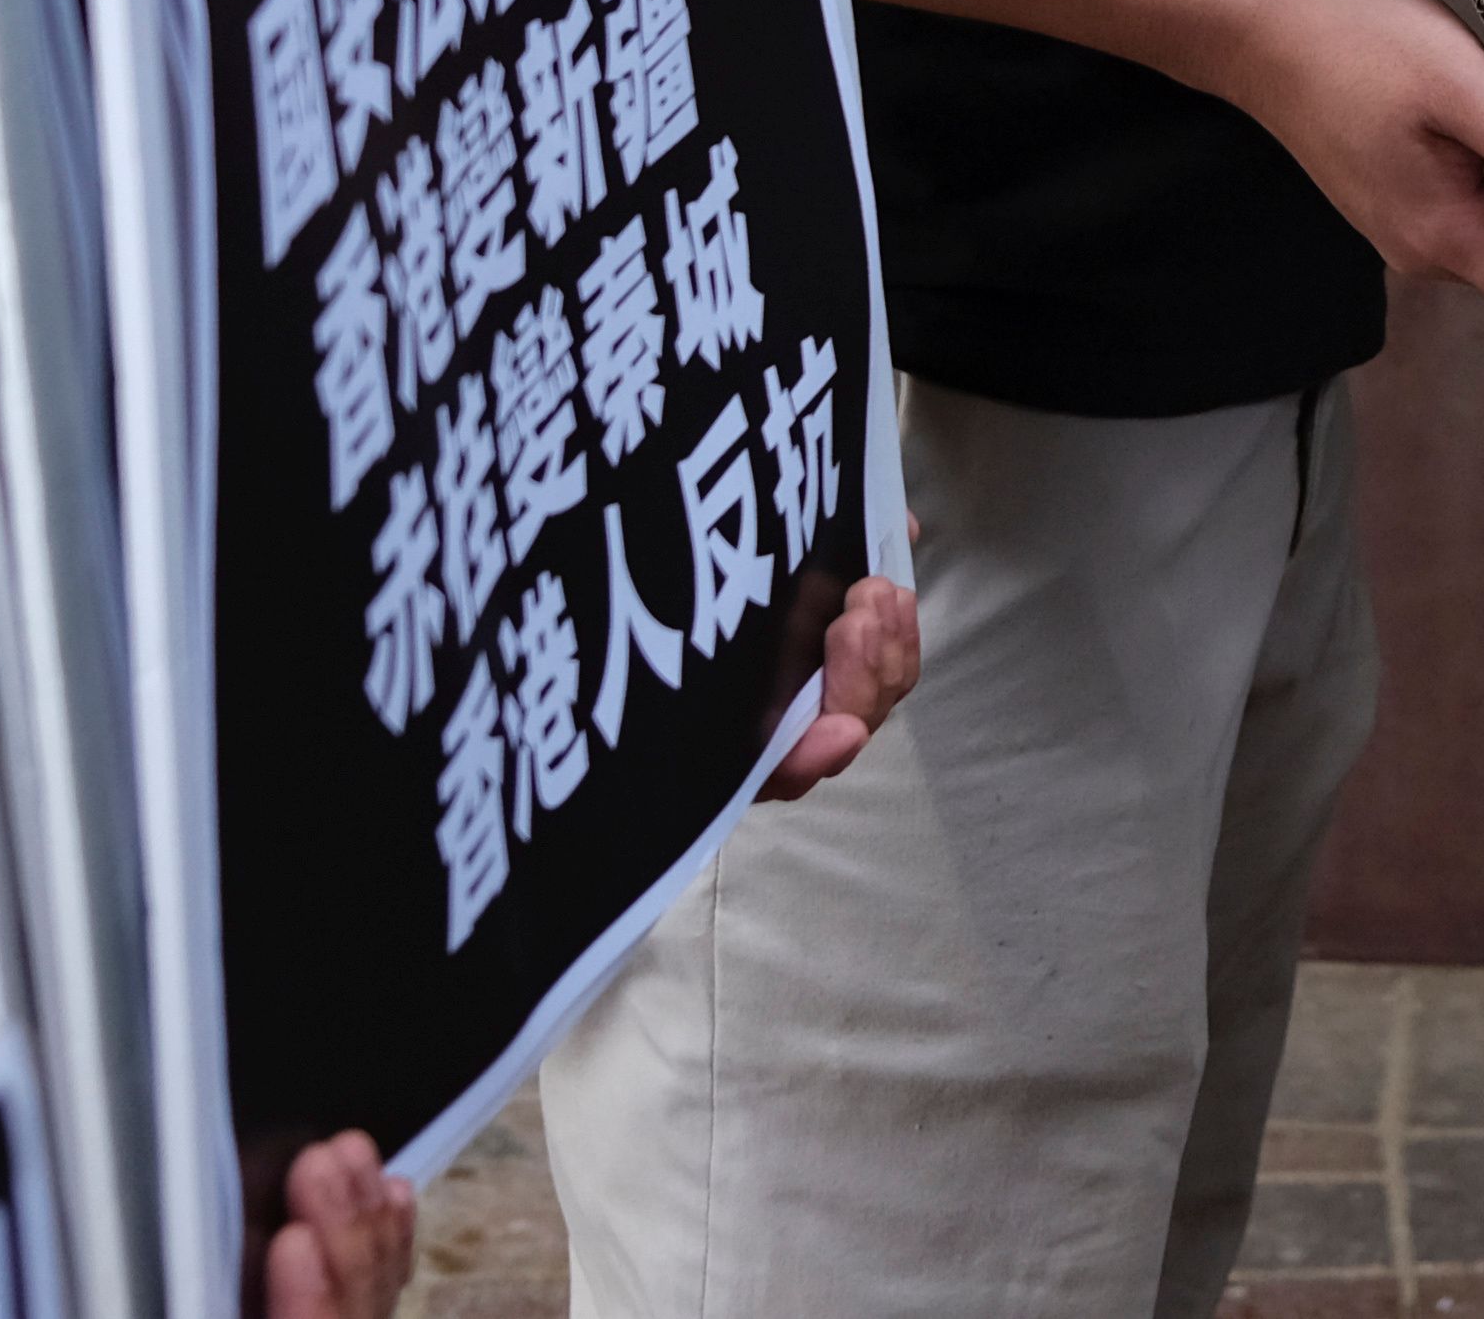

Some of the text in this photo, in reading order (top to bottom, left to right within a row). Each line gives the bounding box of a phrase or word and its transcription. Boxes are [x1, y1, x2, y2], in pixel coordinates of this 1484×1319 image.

[365, 136, 764, 733] 赤柱變秦城
[436, 336, 840, 950] 香港人反抗
